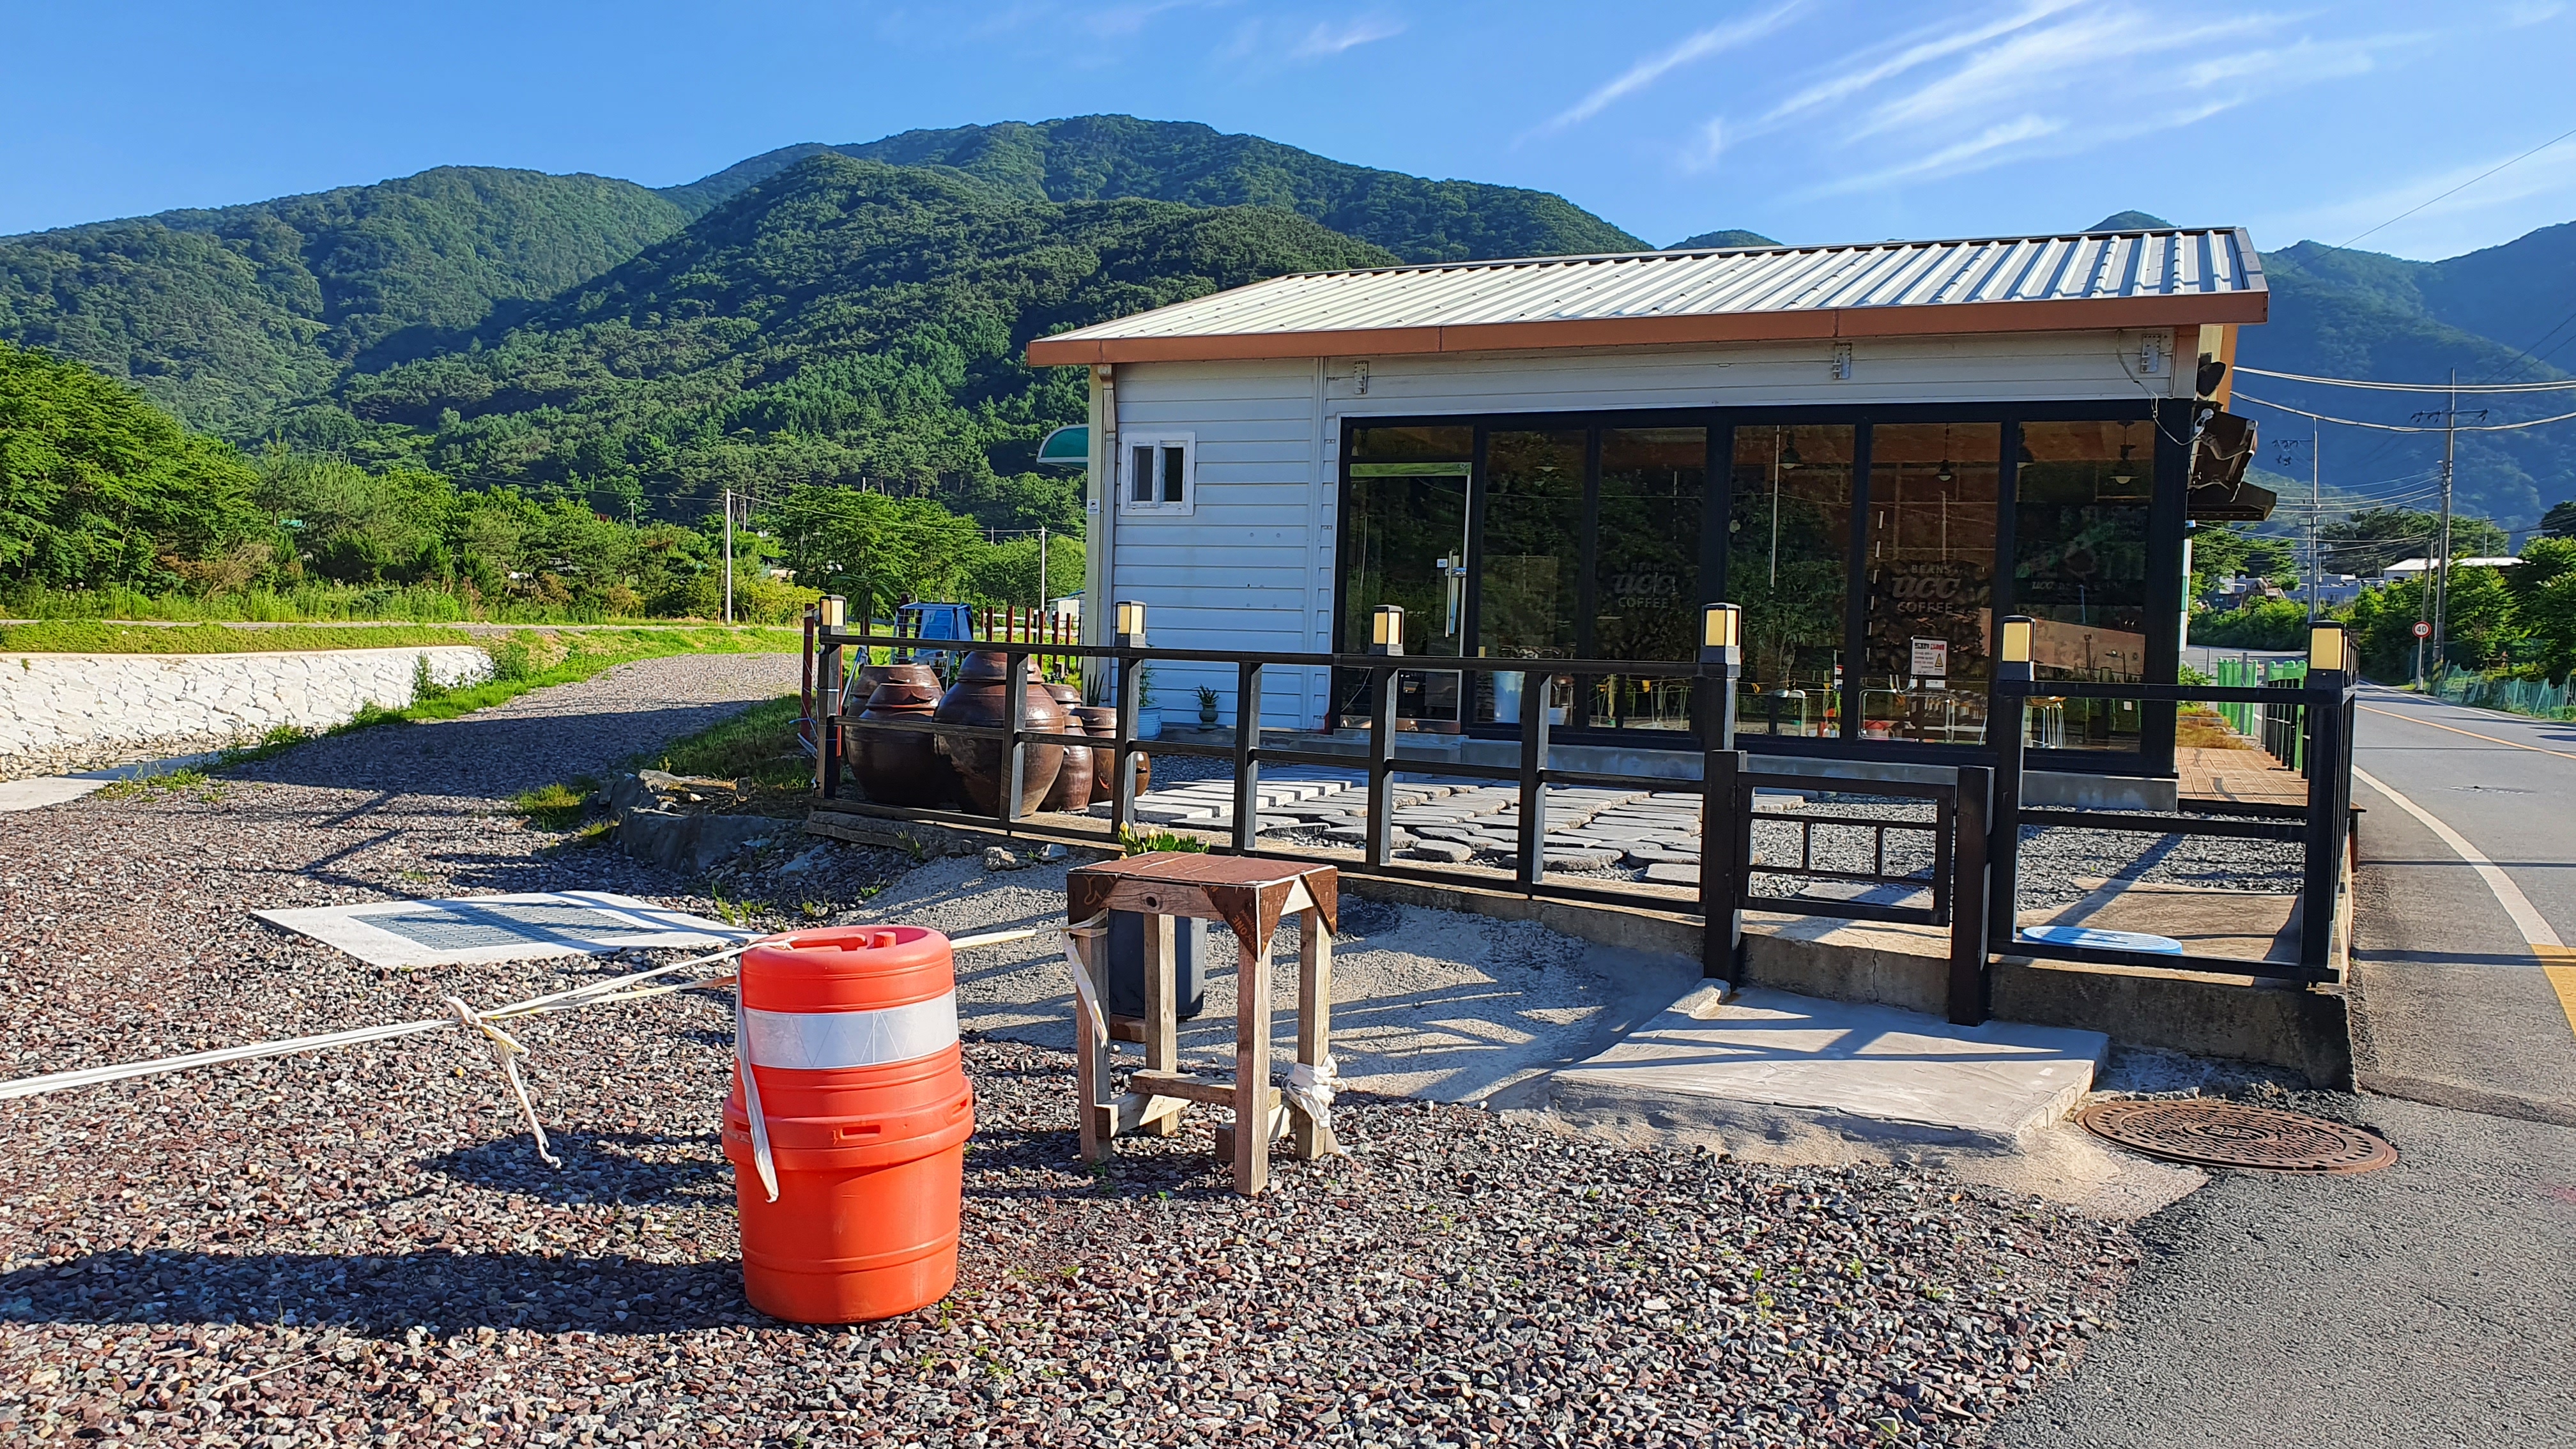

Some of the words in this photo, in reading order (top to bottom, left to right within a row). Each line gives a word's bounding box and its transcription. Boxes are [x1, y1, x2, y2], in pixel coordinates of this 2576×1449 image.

[1912, 564, 1951, 574] BEANS
[1618, 597, 1669, 609] COFFEE
[1897, 601, 1954, 613] COFFEE
[1232, 914, 1248, 935] ONE
